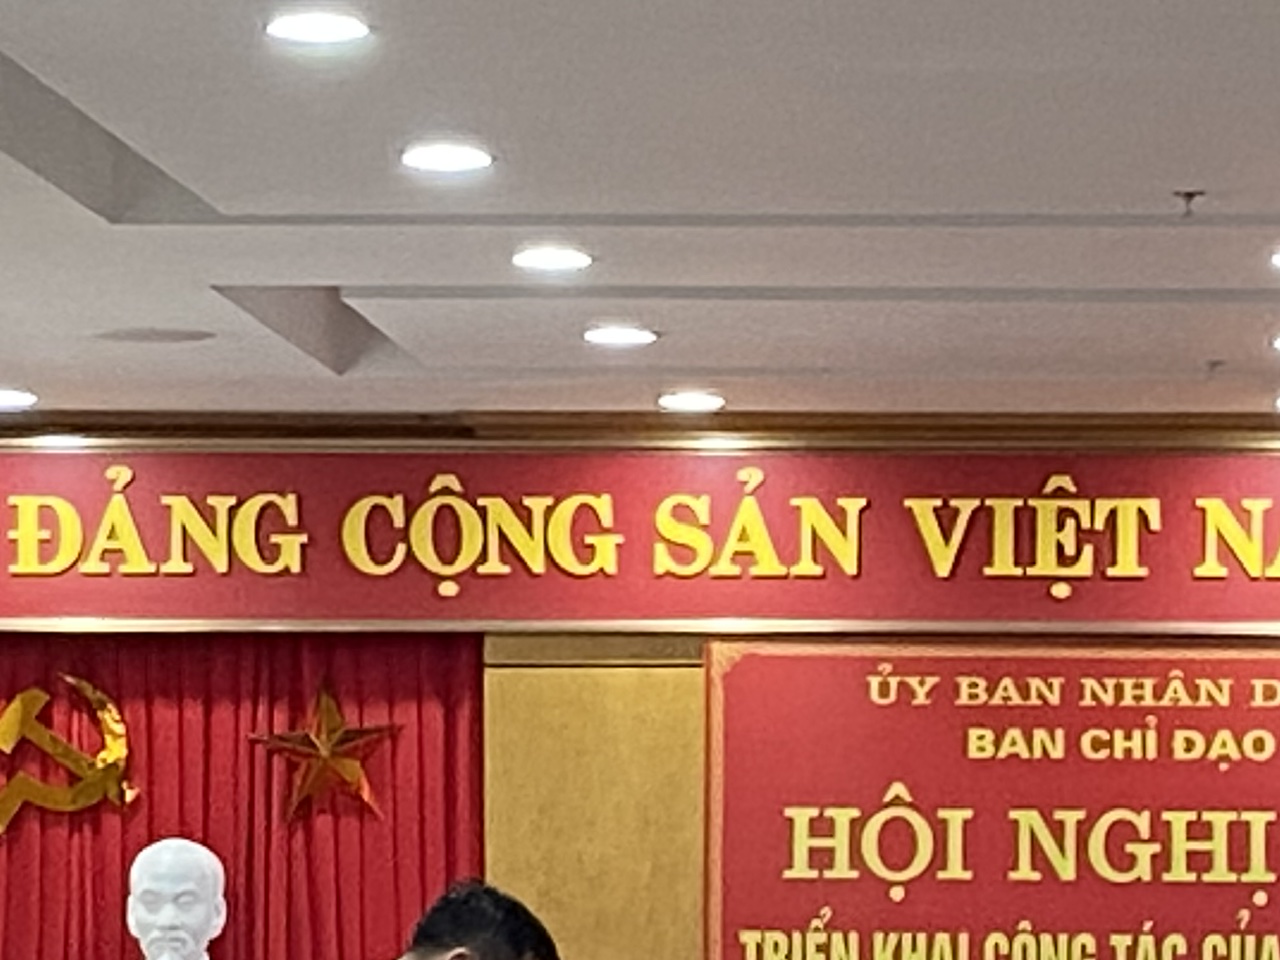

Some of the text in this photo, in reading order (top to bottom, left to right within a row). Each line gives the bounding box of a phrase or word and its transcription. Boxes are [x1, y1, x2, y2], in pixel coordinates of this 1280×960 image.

[5, 464, 309, 578] ĐẢNG
[341, 473, 625, 597] CỘNG
[652, 466, 867, 578] SẢN
[903, 474, 1161, 599] VIỆT
[866, 662, 940, 706] ỦY
[954, 676, 1065, 707] BAN
[1079, 669, 1234, 708] NHÂN
[966, 727, 1065, 760] BAN
[1080, 715, 1159, 762] CHỈ
[1171, 728, 1277, 772] ĐẠO
[782, 781, 974, 903] HỘI
[1008, 808, 1277, 907] NGHỊ
